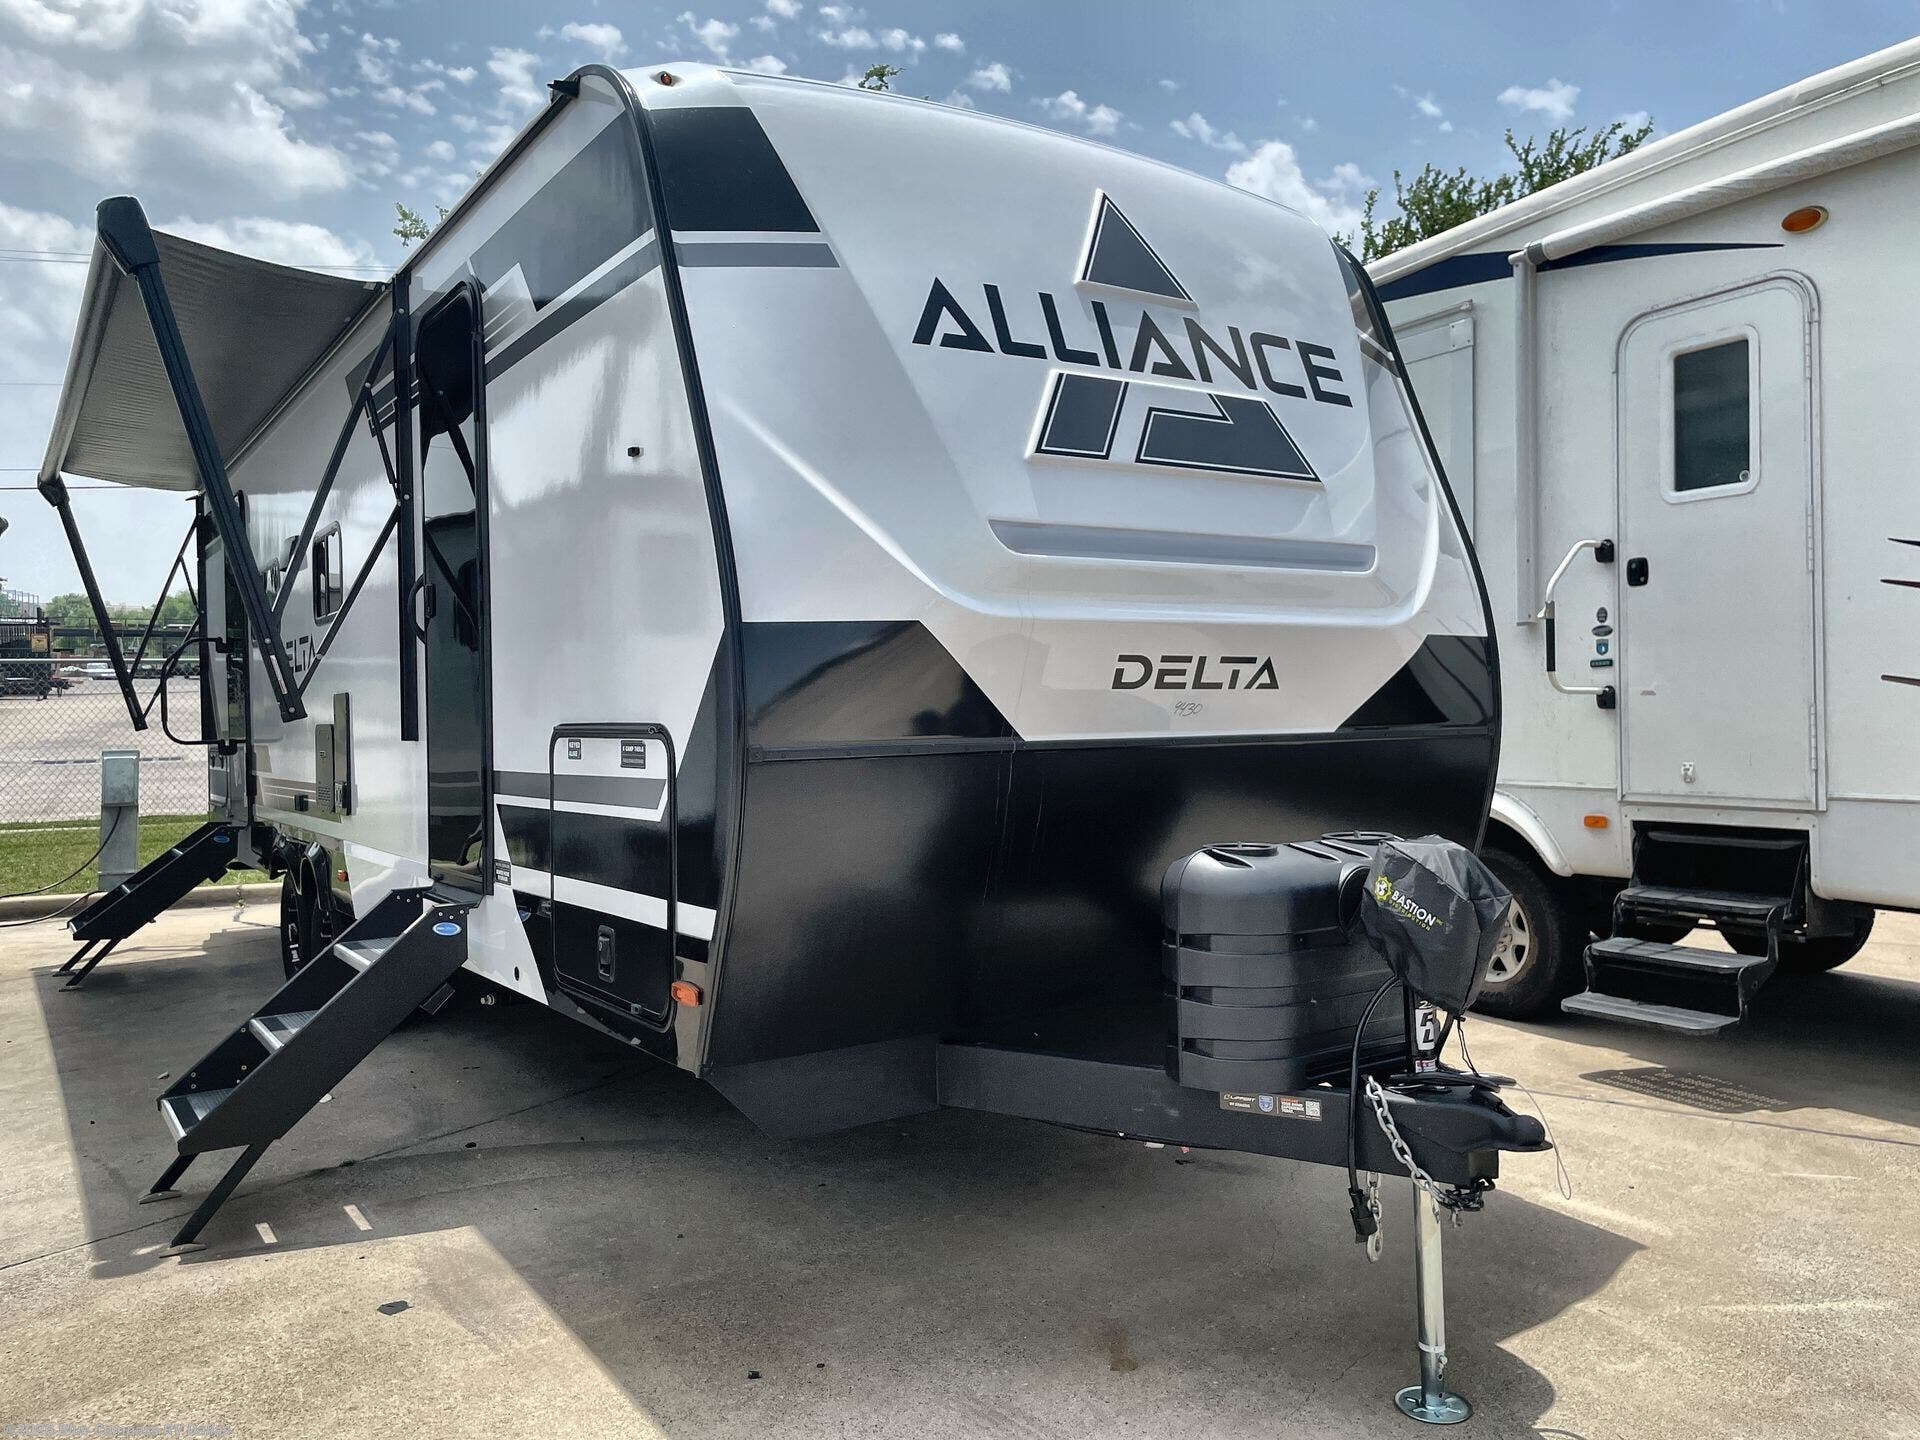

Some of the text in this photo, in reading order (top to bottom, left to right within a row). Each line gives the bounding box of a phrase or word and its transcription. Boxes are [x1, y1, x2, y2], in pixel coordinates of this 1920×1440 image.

[912, 276, 1353, 408] ALLIANCE
[285, 633, 316, 673] ELTA
[1111, 654, 1279, 690] DELTA
[1388, 900, 1431, 931] DISTRIBUTION
[1391, 890, 1437, 927] BASTION
